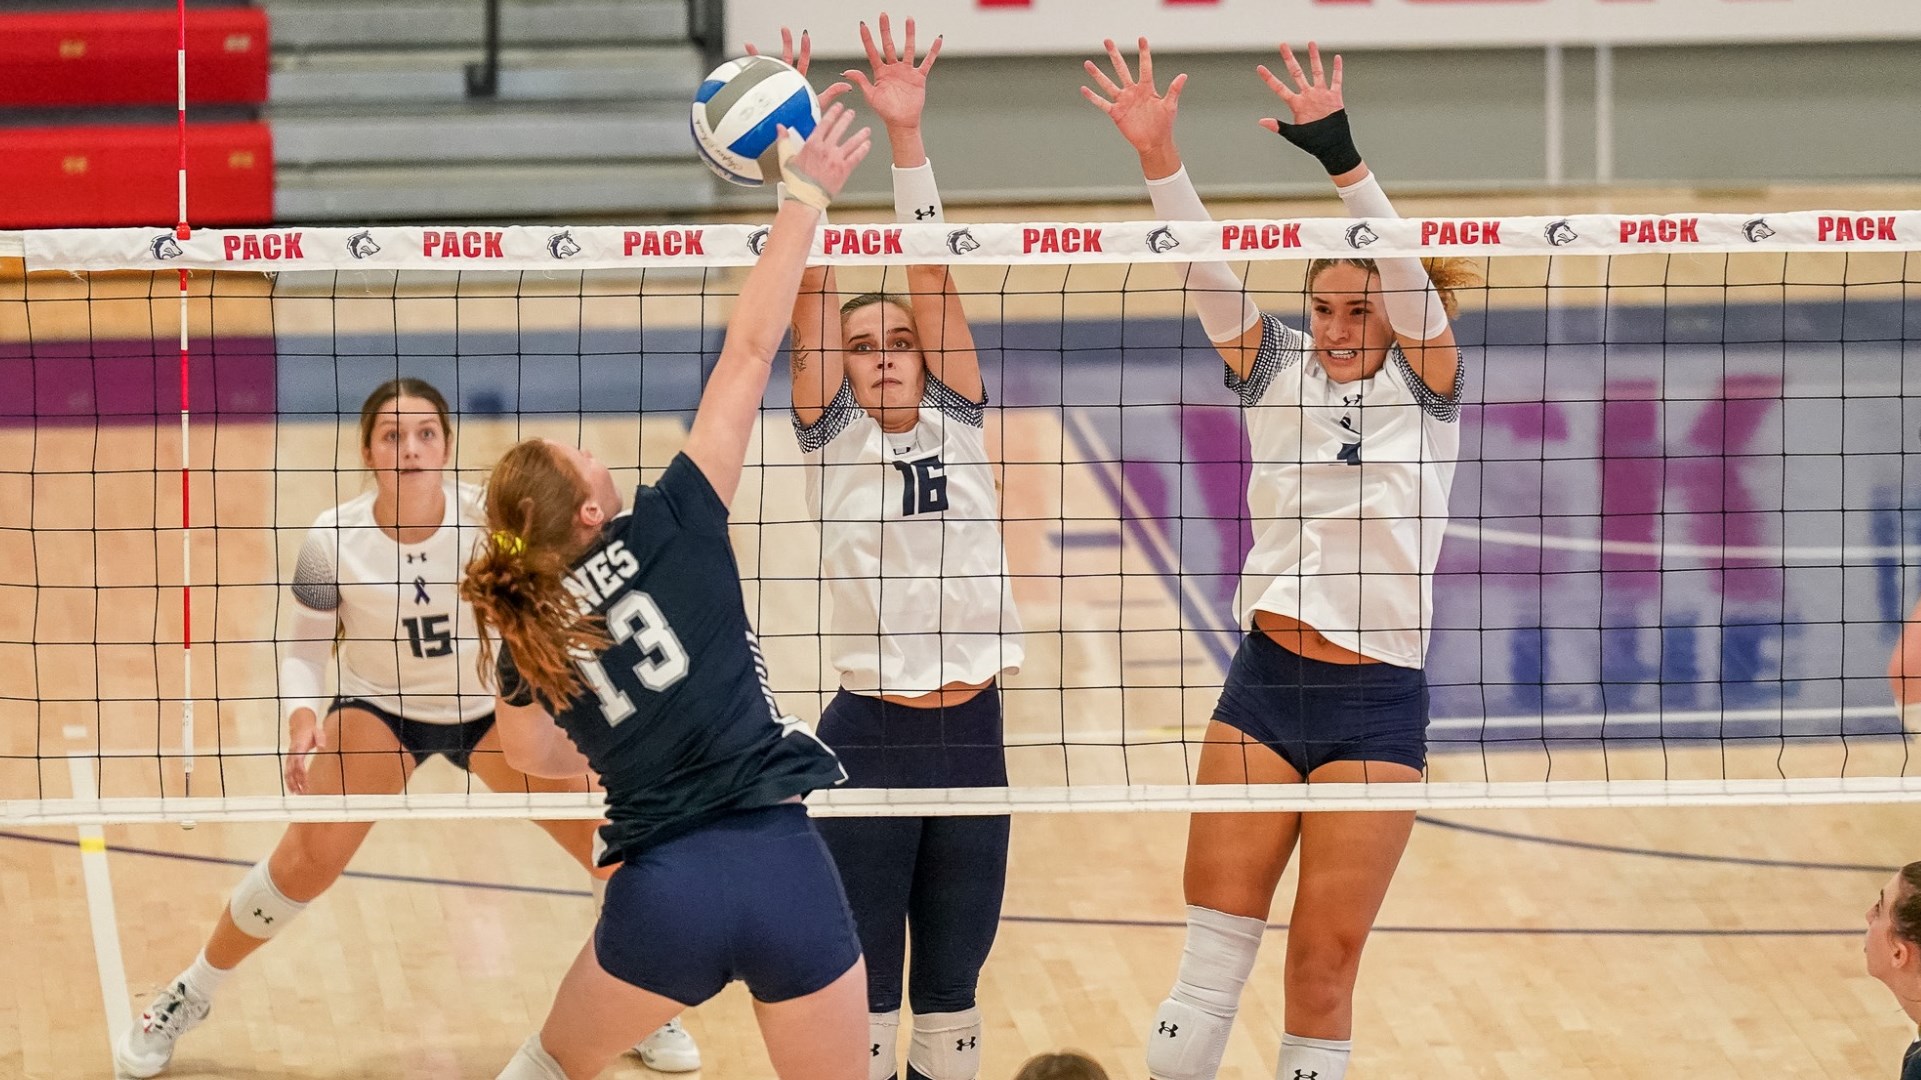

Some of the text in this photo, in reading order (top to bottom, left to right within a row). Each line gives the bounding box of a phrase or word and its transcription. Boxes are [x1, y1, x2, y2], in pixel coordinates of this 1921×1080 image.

[224, 217, 1896, 261] PACK PACK PACK PACK PACK PACK PACK PACK PACK
[891, 454, 949, 517] 16
[560, 539, 640, 618] NES
[402, 613, 453, 658] 15
[565, 588, 691, 728] 13
